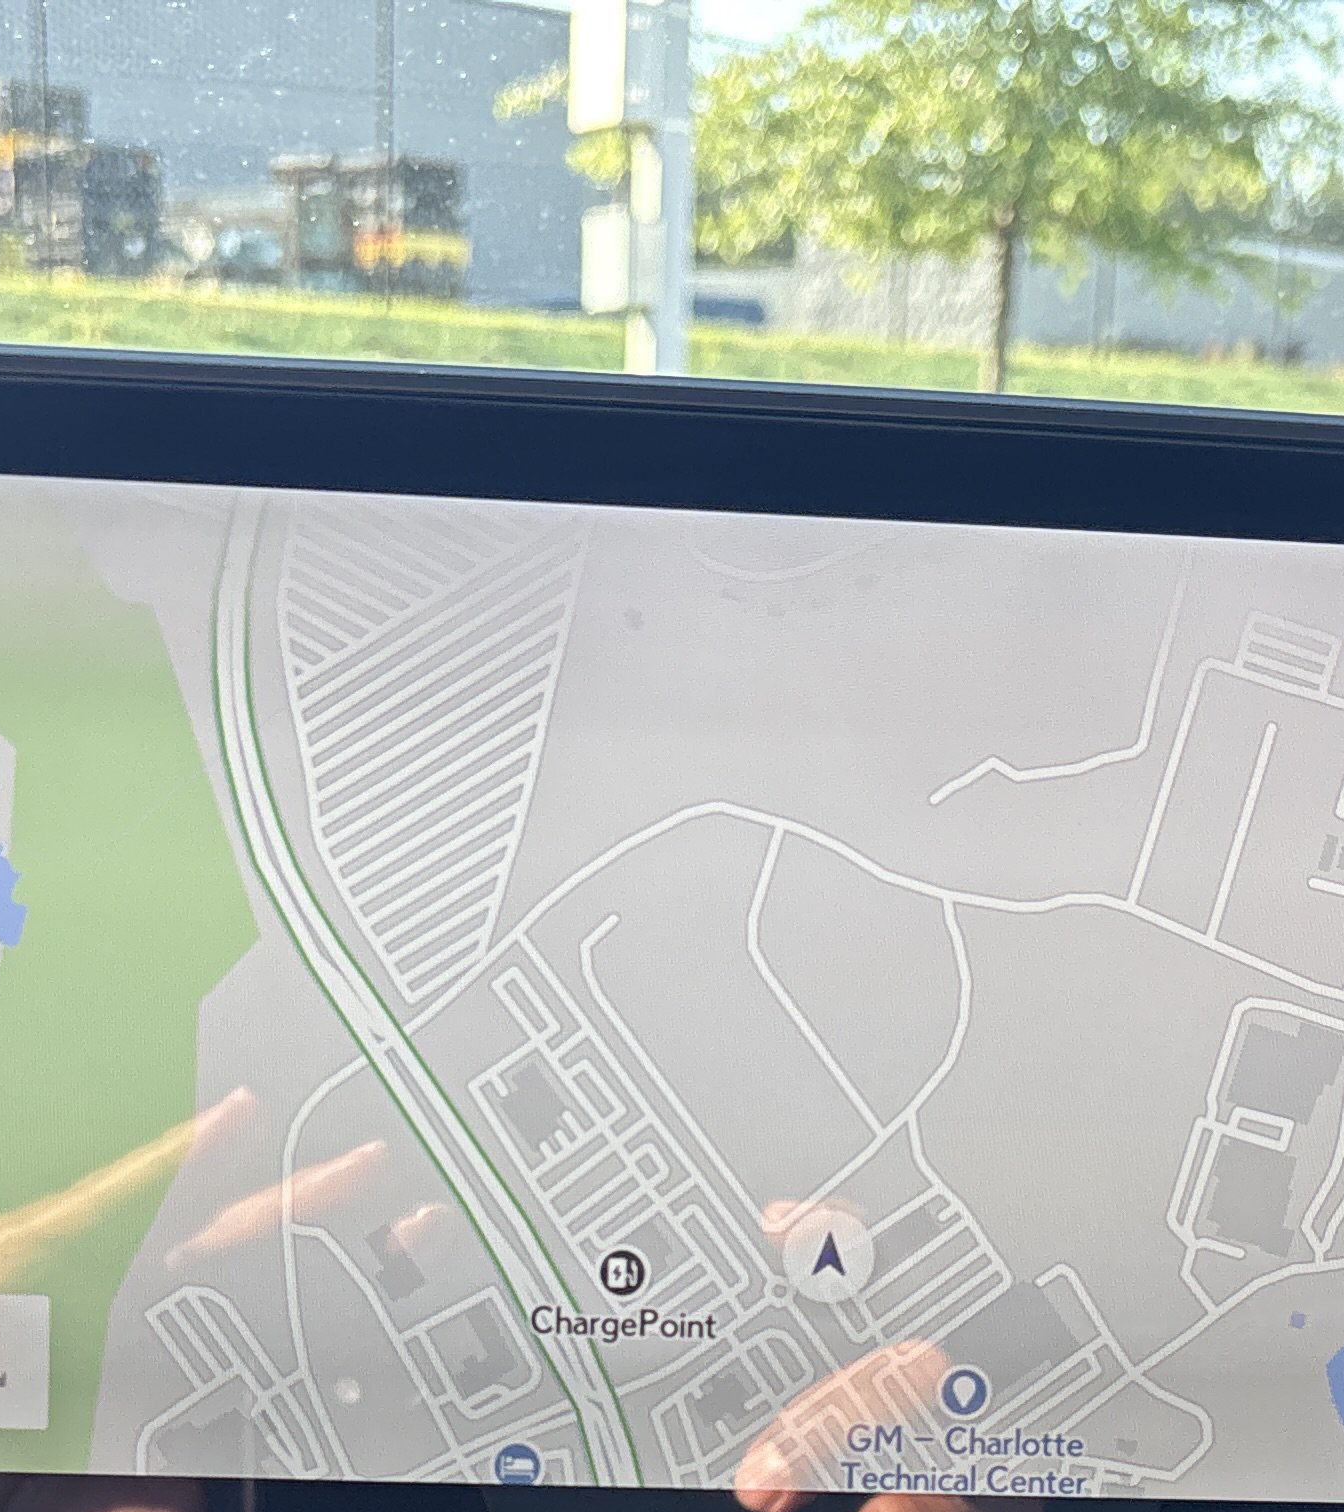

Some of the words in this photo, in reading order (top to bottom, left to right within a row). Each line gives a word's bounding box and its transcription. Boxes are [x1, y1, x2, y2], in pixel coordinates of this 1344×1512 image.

[531, 1305, 716, 1343] ChargePoint
[847, 1424, 903, 1452] GM
[945, 1426, 1084, 1457] Charlotte
[841, 1462, 976, 1492] Technical
[987, 1466, 1086, 1495] Center
